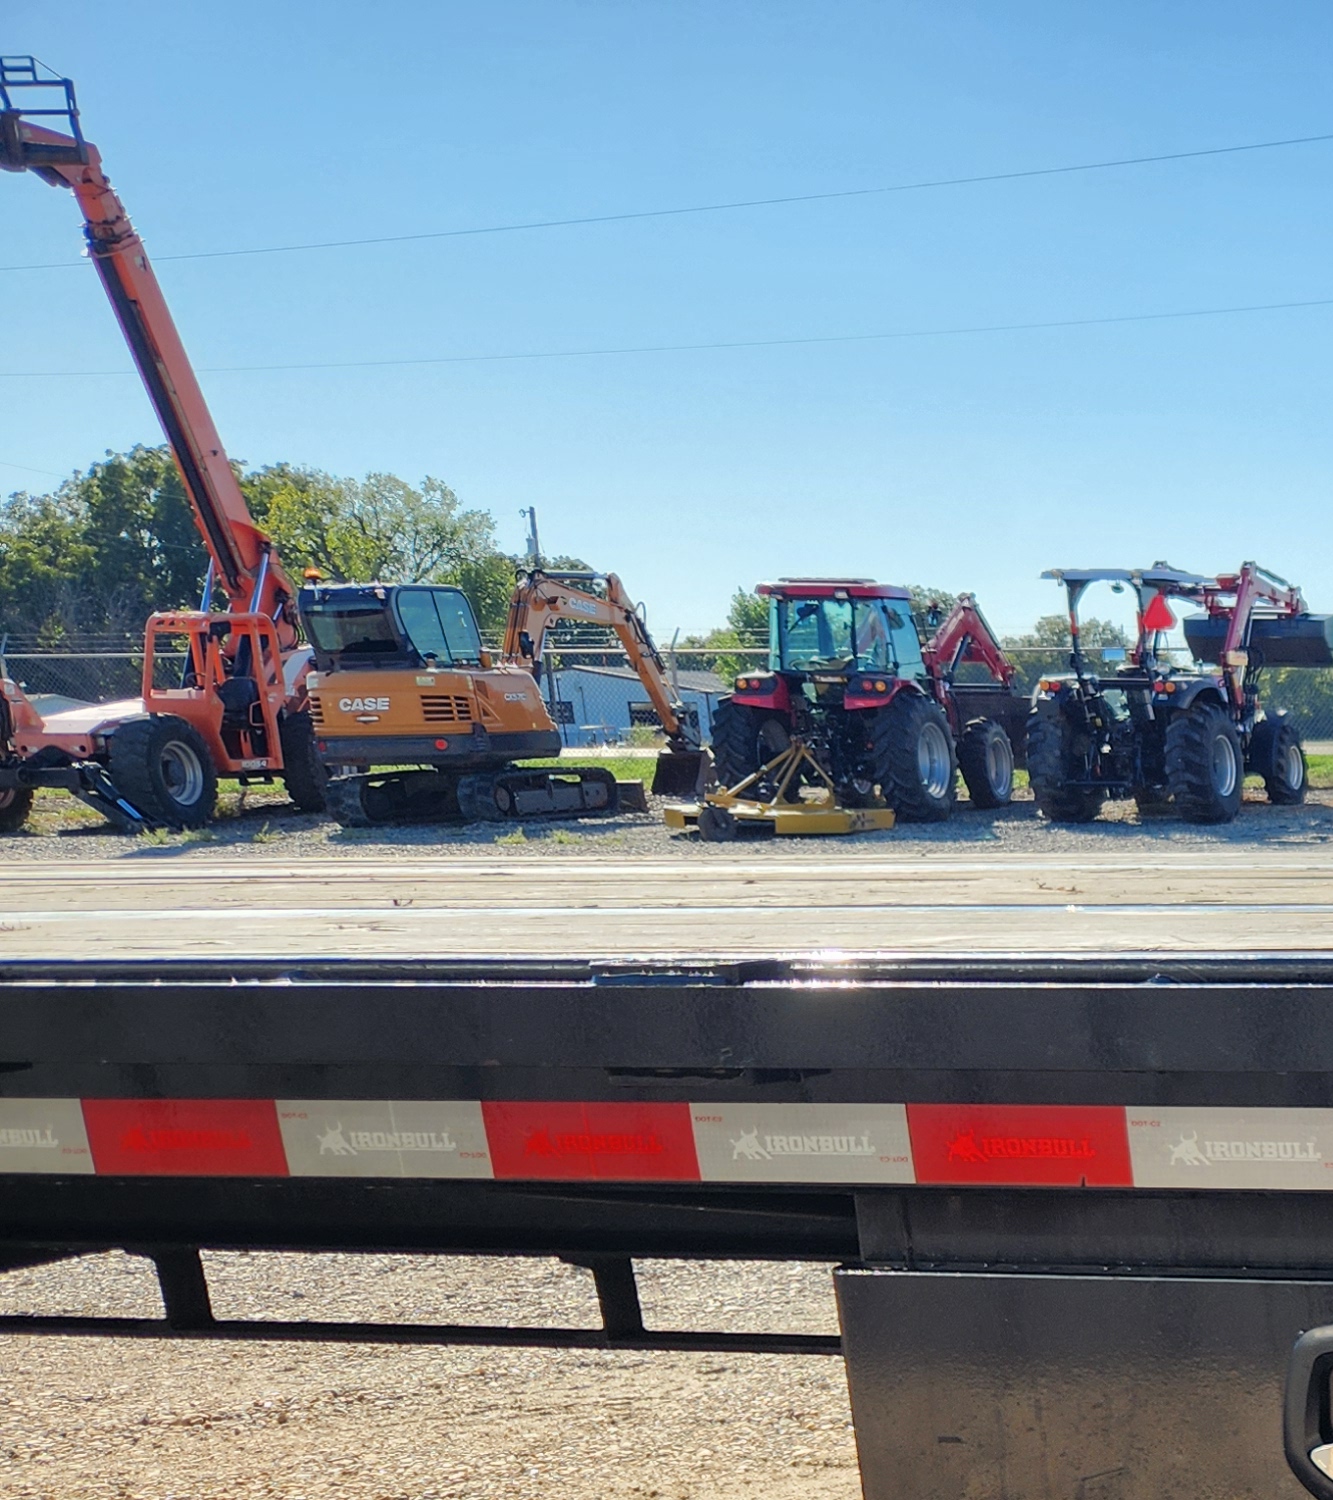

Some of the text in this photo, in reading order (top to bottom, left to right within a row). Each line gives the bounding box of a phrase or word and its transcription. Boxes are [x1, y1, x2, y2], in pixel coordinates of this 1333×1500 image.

[568, 597, 597, 615] CASE
[338, 697, 390, 712] CASE
[349, 1131, 456, 1150] IRONBULL
[765, 1135, 876, 1153] IRONBULL
[981, 1138, 1096, 1157] IRONBULL
[1205, 1141, 1321, 1159] IRONBULL
